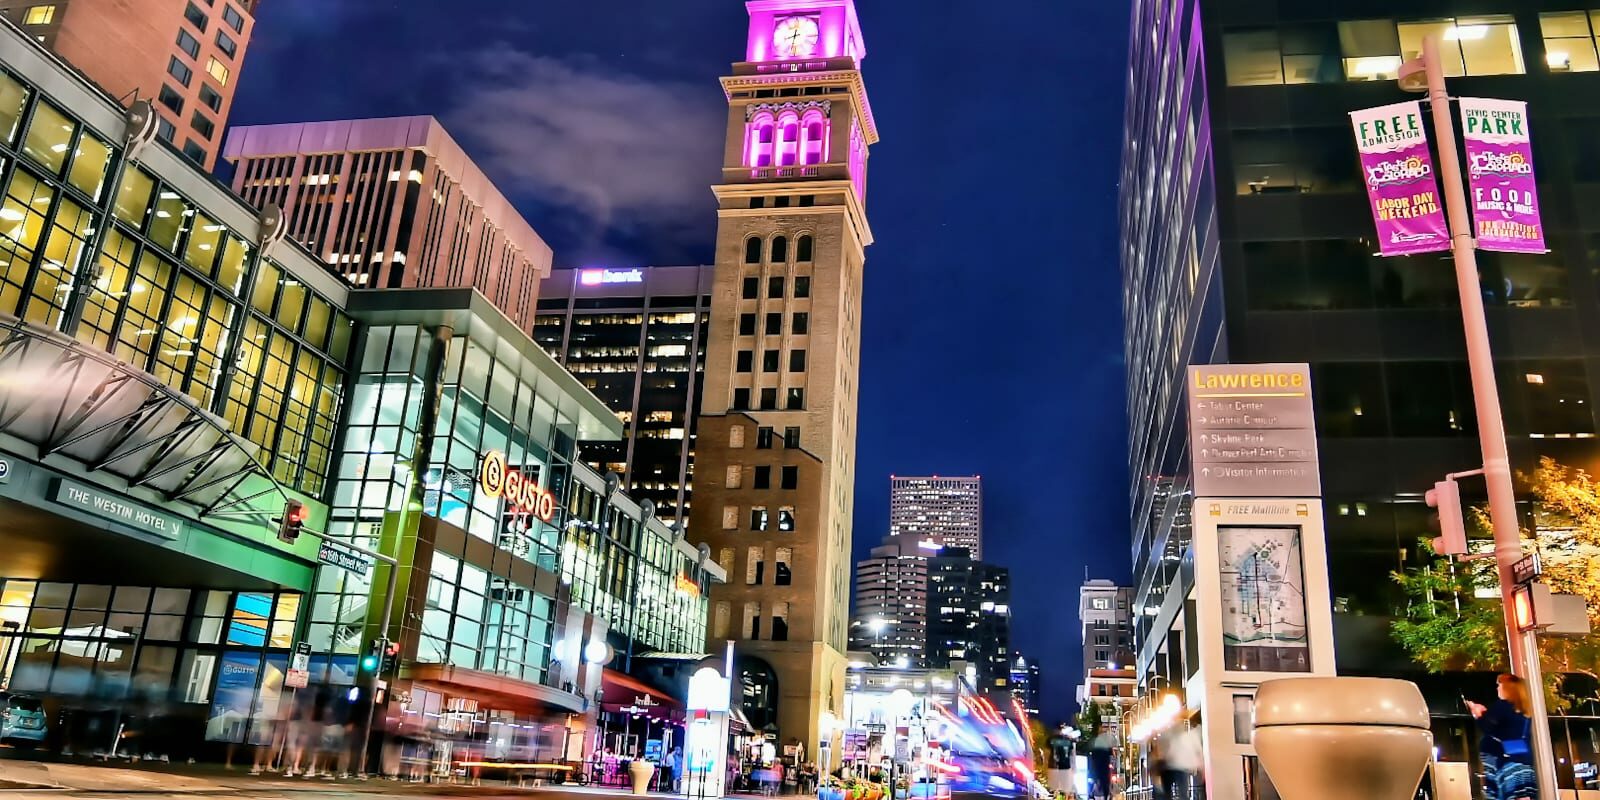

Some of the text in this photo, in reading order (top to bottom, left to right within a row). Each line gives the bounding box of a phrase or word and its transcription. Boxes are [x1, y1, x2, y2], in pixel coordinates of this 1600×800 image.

[1466, 109, 1521, 120] CIVIC CENTER
[1359, 113, 1419, 140] FREE
[1467, 117, 1524, 136] PARK
[1362, 129, 1421, 148] ADMISSION
[1375, 191, 1434, 211] LABOR DAY
[1475, 187, 1532, 206] FOOD
[1378, 202, 1438, 221] WEEKEND
[1477, 200, 1536, 215] MUSIC & MORE
[1194, 369, 1304, 389] Lawrence
[1234, 401, 1264, 411] Center
[1211, 433, 1264, 444] Skyline Park
[1225, 466, 1253, 477] Visitor
[505, 471, 553, 520] GUSTO
[68, 487, 166, 530] THE WESTIN HOTEL
[1227, 505, 1250, 514] FREE
[338, 553, 356, 571] Street
[355, 559, 368, 574] Mall
